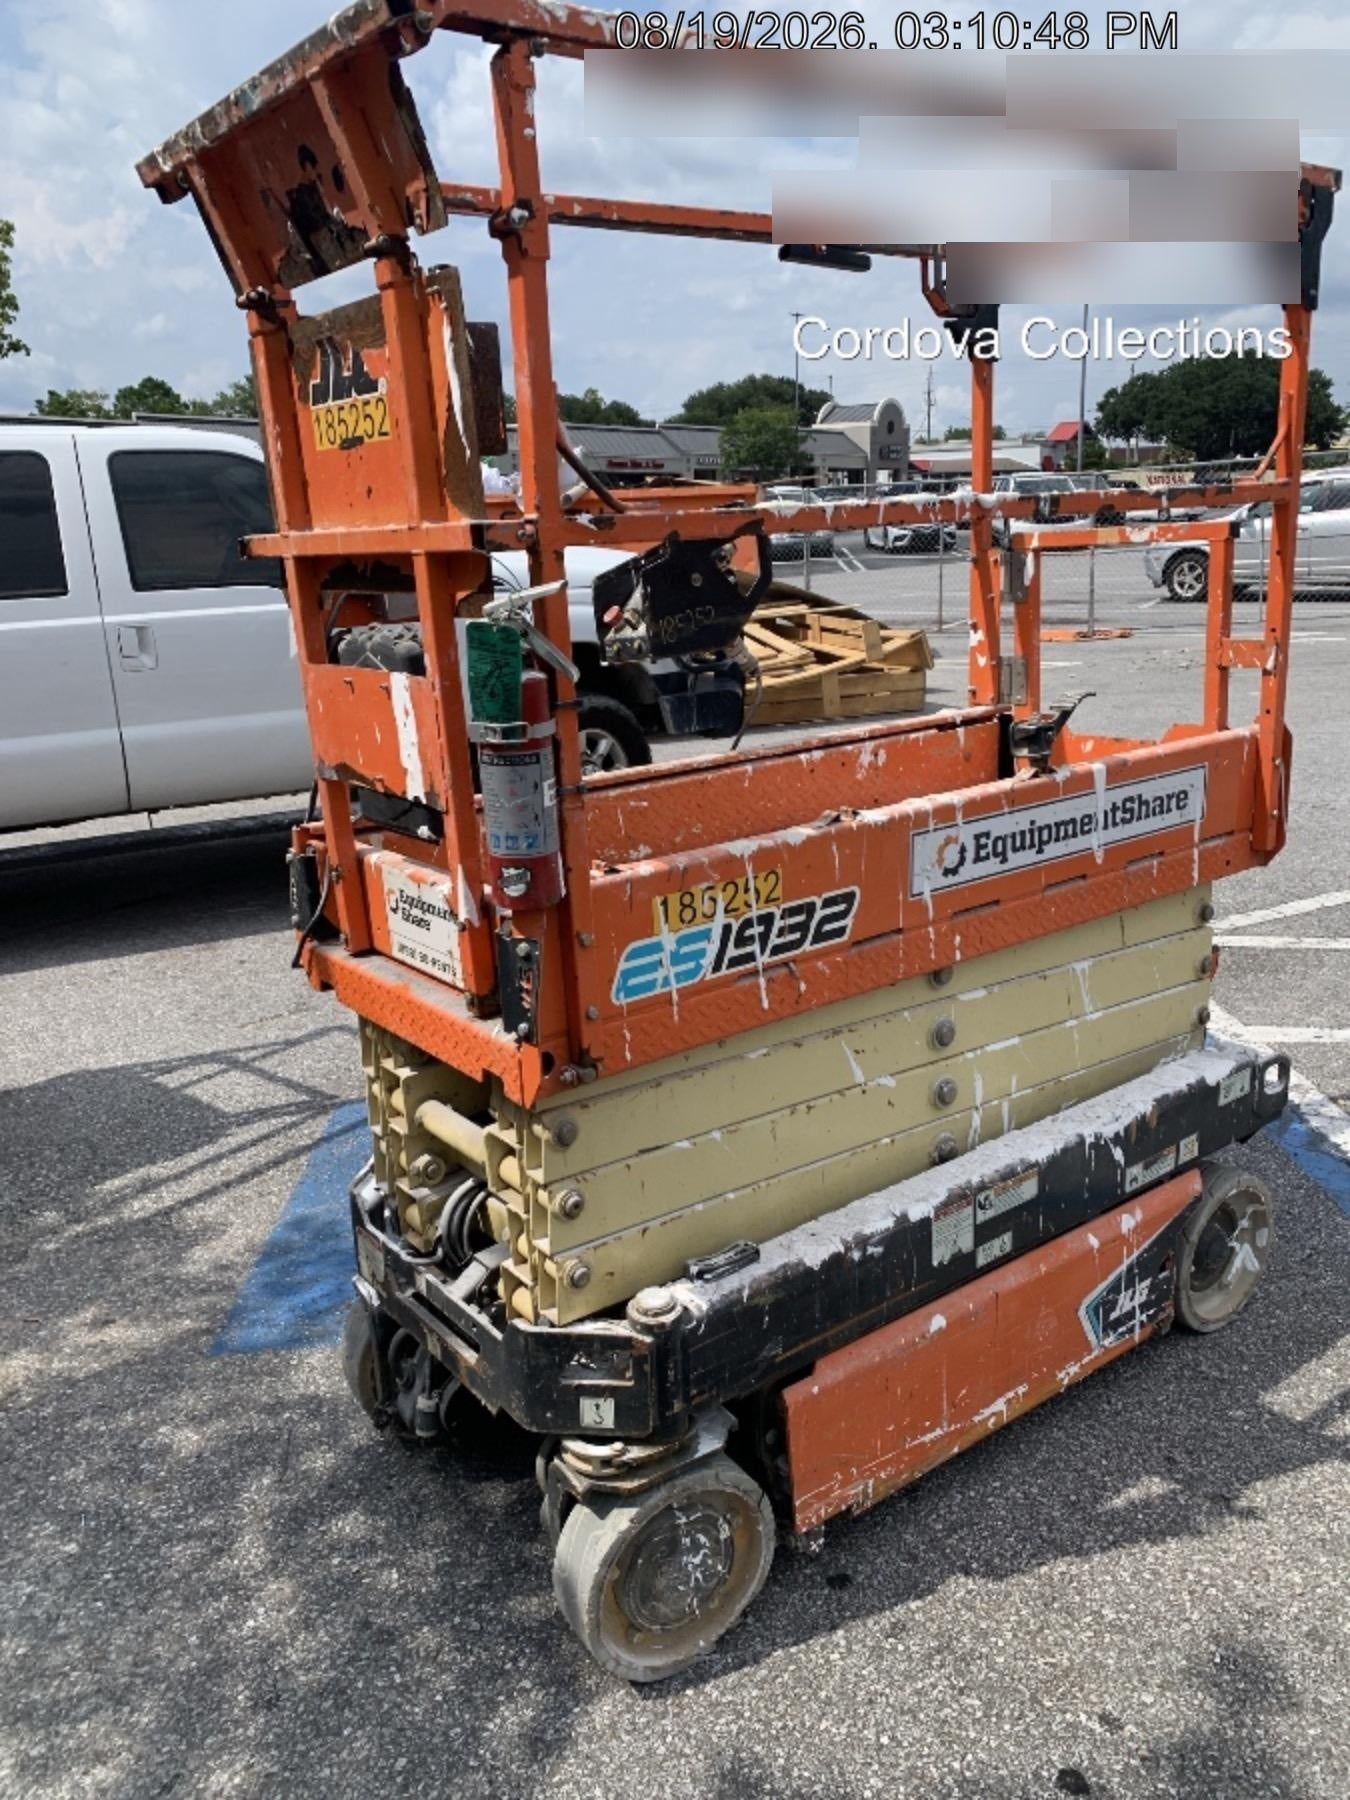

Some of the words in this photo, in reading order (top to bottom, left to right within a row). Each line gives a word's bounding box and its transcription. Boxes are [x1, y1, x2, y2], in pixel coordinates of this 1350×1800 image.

[314, 398, 389, 447] 185252
[972, 789, 1189, 864] EquipmentShare
[657, 869, 781, 925] 185252
[612, 886, 860, 1004] ES1932
